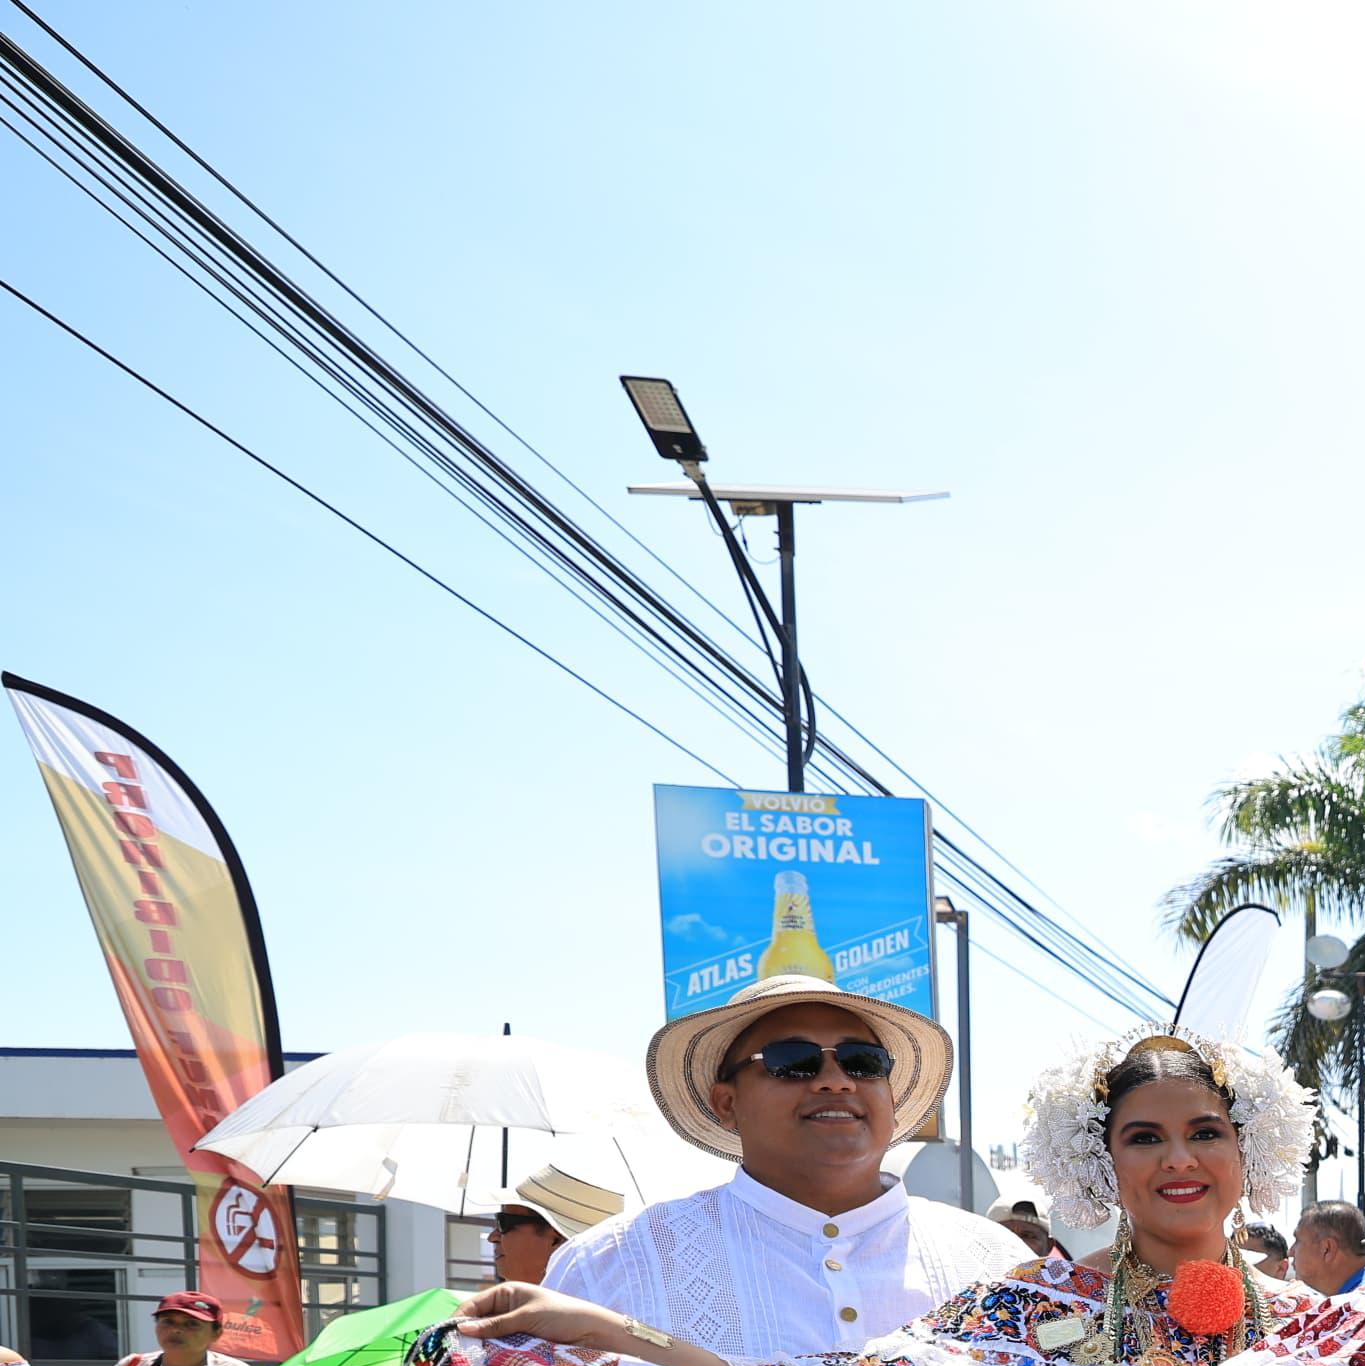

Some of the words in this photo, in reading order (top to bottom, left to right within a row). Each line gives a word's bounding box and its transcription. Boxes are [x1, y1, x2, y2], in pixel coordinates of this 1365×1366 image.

[751, 794, 826, 813] VOLVIÓ
[725, 812, 755, 832] EL
[760, 814, 853, 836] SABOR
[702, 833, 880, 864] ORIGINAL
[687, 953, 753, 996] ATLAS
[835, 928, 910, 972] GOLDEN
[847, 976, 869, 990] CON
